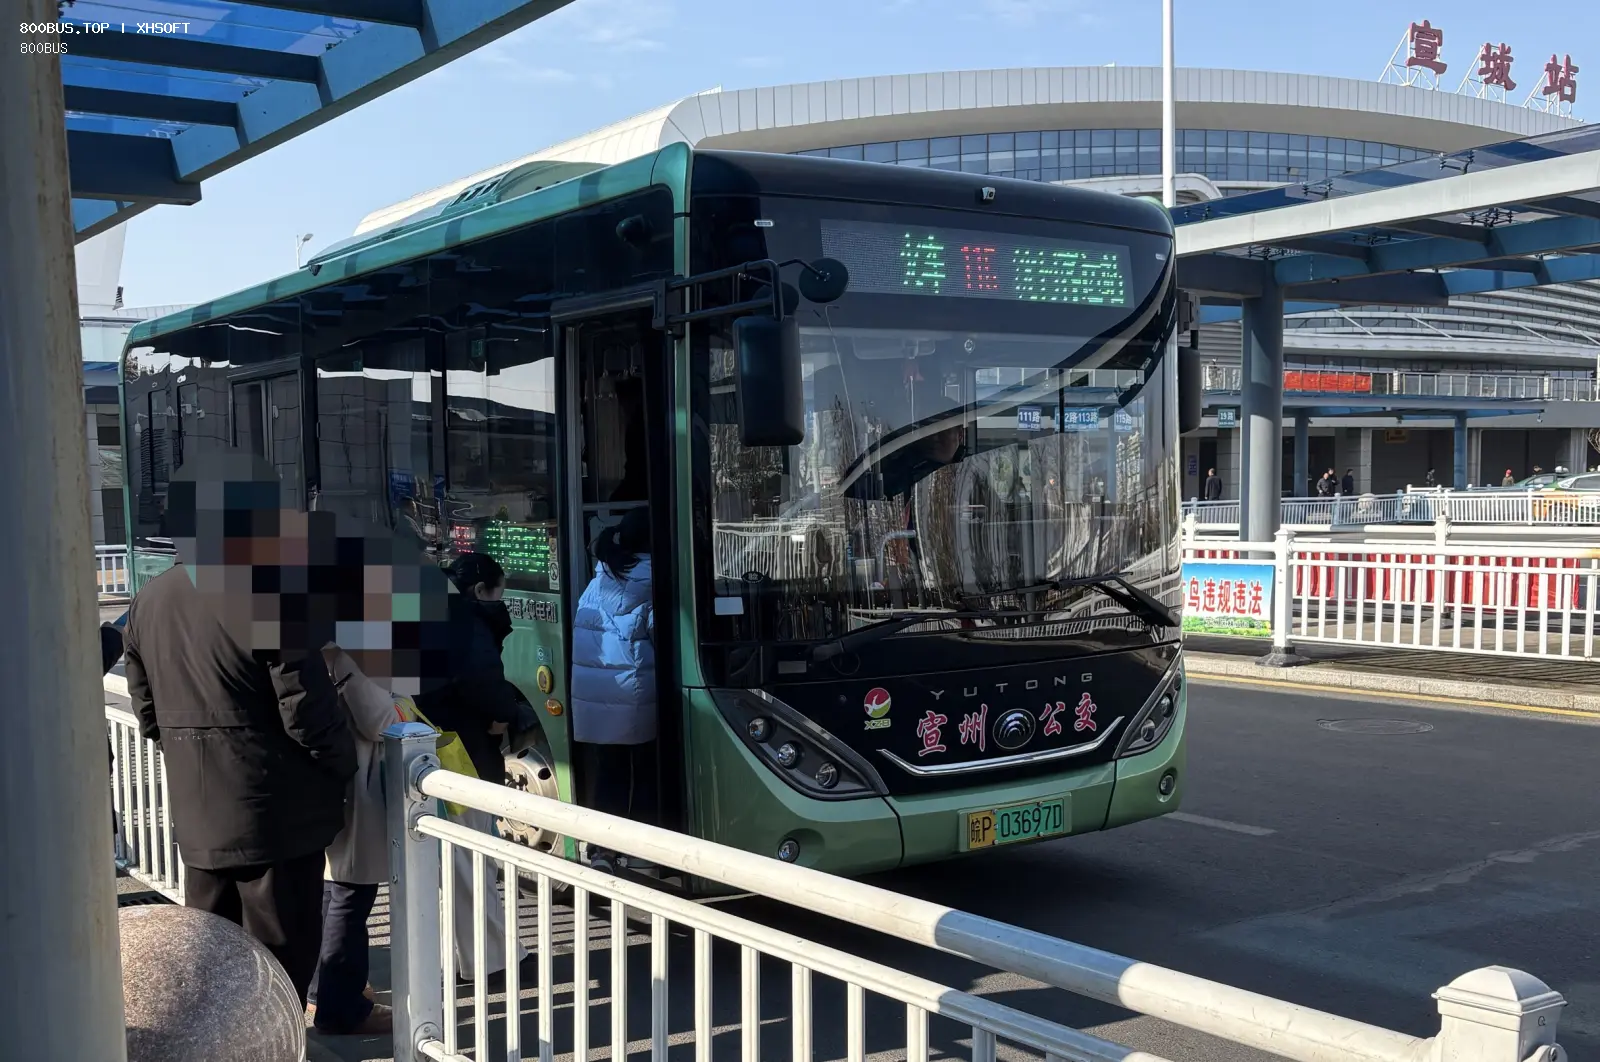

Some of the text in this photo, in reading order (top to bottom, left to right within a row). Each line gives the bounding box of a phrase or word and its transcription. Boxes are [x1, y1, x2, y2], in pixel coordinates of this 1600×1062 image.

[1406, 19, 1580, 104] 宣城站
[1019, 411, 1040, 423] 111路
[1078, 412, 1098, 423] 113路
[1182, 577, 1263, 616] 鸟违规违法
[930, 672, 1093, 701] YUTONG
[916, 692, 1098, 757] 宣州公交
[1000, 804, 1062, 838] 03697D
